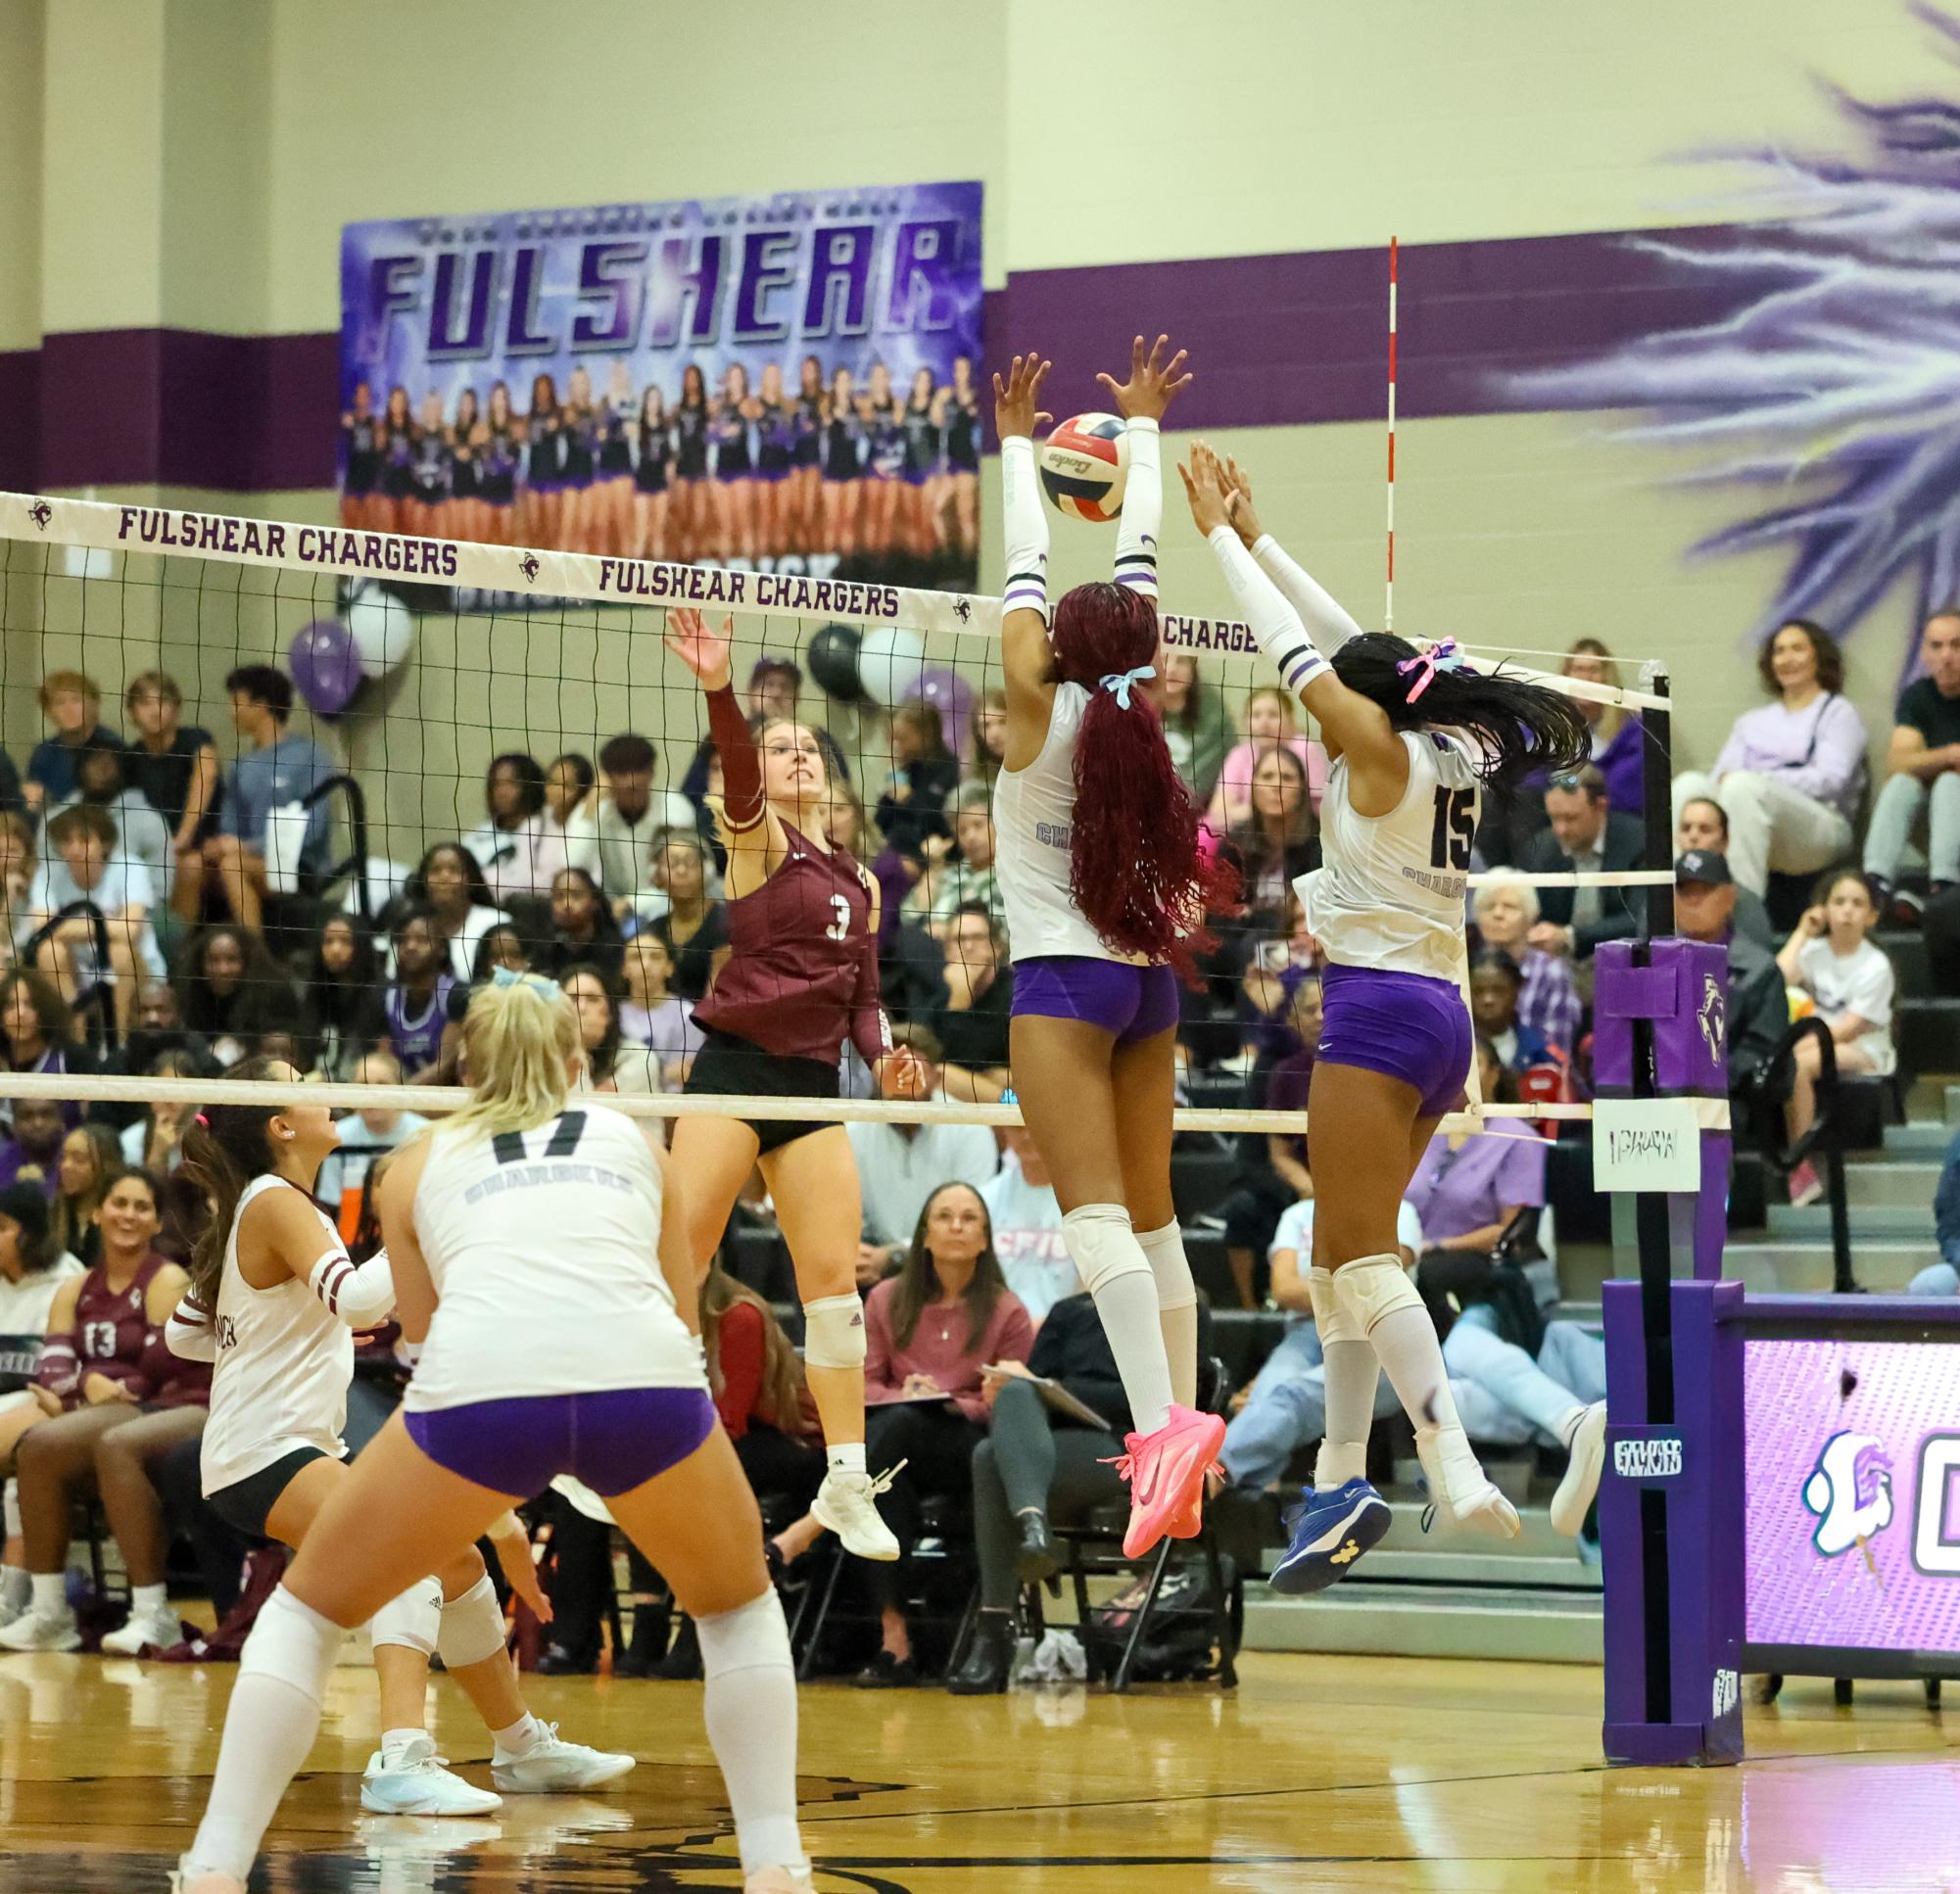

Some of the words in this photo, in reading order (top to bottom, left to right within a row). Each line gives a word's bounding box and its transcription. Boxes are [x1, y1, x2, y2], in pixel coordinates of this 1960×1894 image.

[362, 219, 964, 362] FULSHEAR
[119, 506, 285, 557] FULSHEAR
[298, 528, 457, 577] CHARGERS
[599, 559, 745, 603] FULSHEAR
[756, 575, 899, 618] CHARGERS
[1163, 615, 1260, 654] CHARGE
[1429, 783, 1476, 871] 15
[826, 893, 851, 941] 3
[84, 1321, 118, 1358] 13
